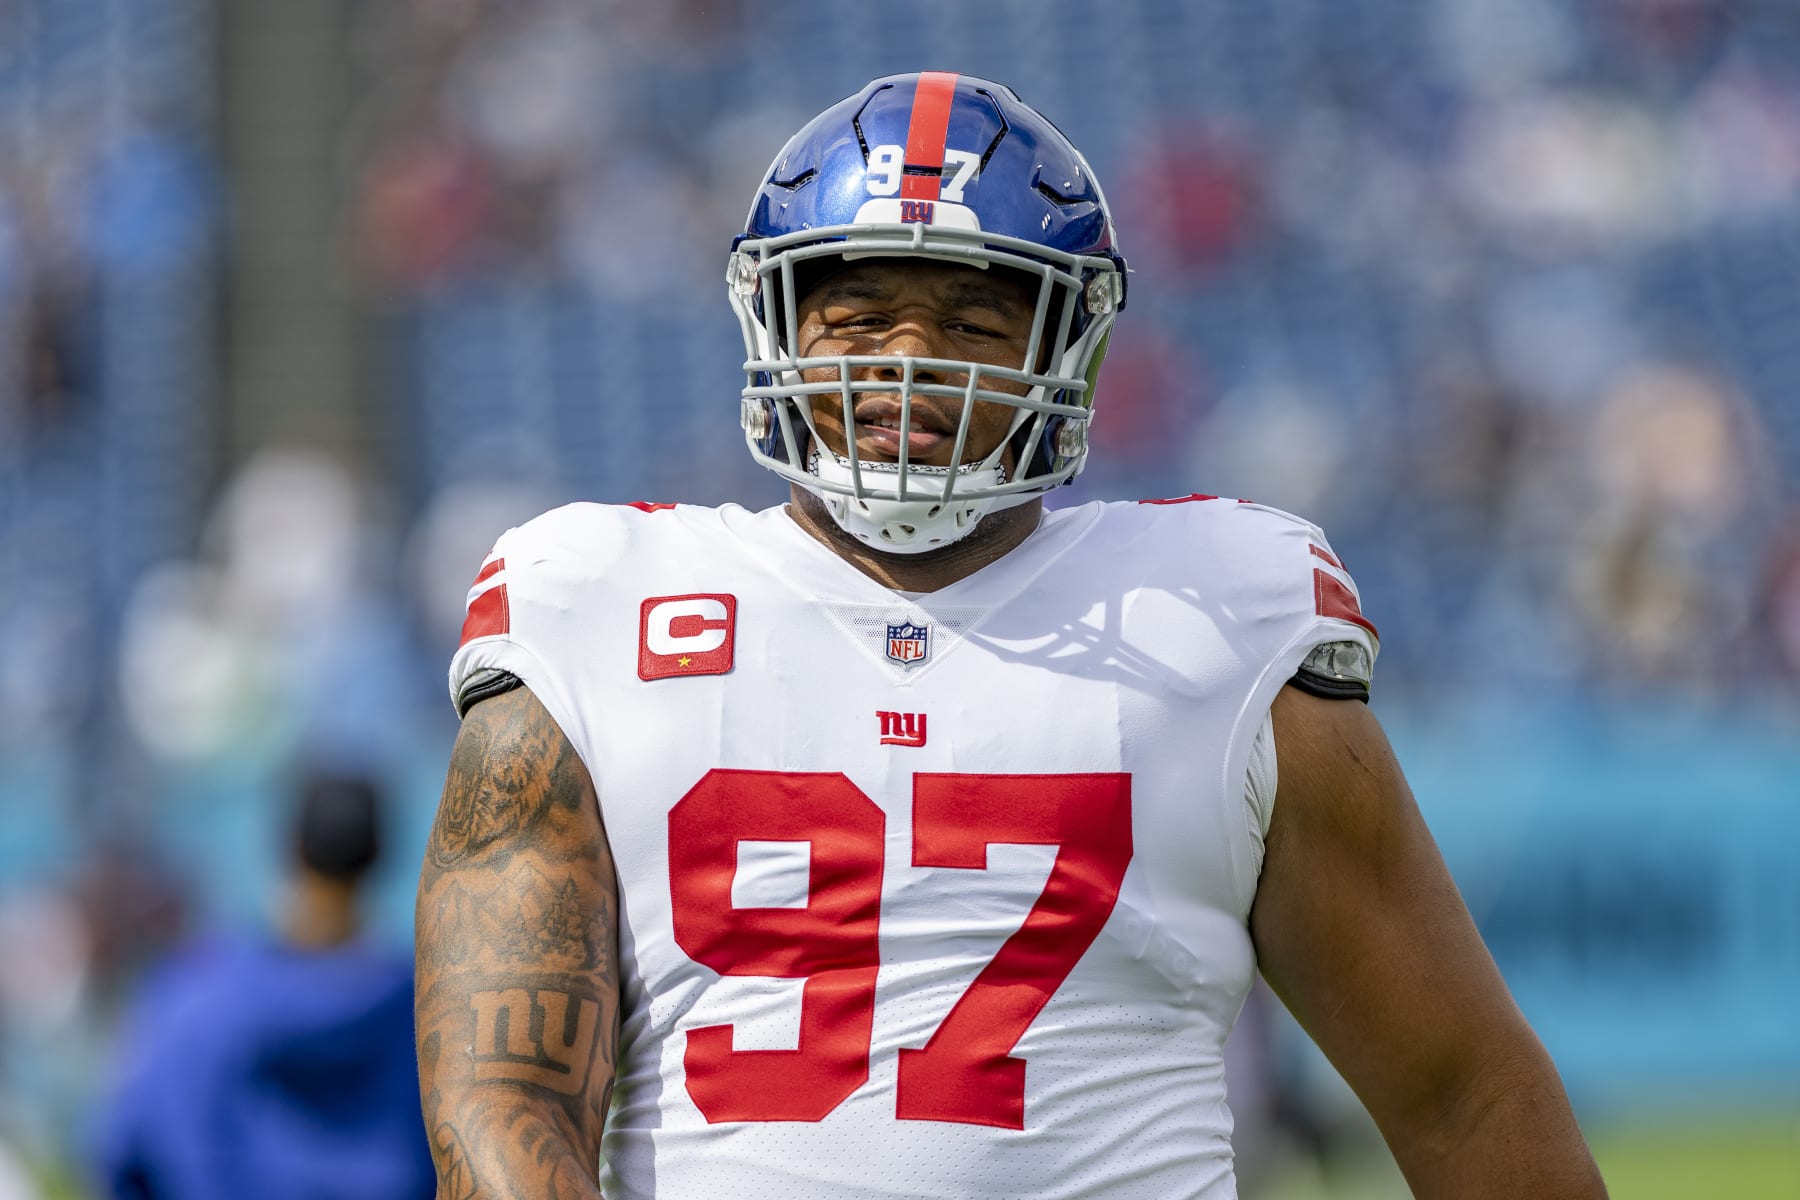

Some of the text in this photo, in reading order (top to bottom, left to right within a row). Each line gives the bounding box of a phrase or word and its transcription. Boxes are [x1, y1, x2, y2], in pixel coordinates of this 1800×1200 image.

[647, 598, 728, 656] C
[890, 639, 924, 661] NFL
[668, 769, 1133, 1130] 97
